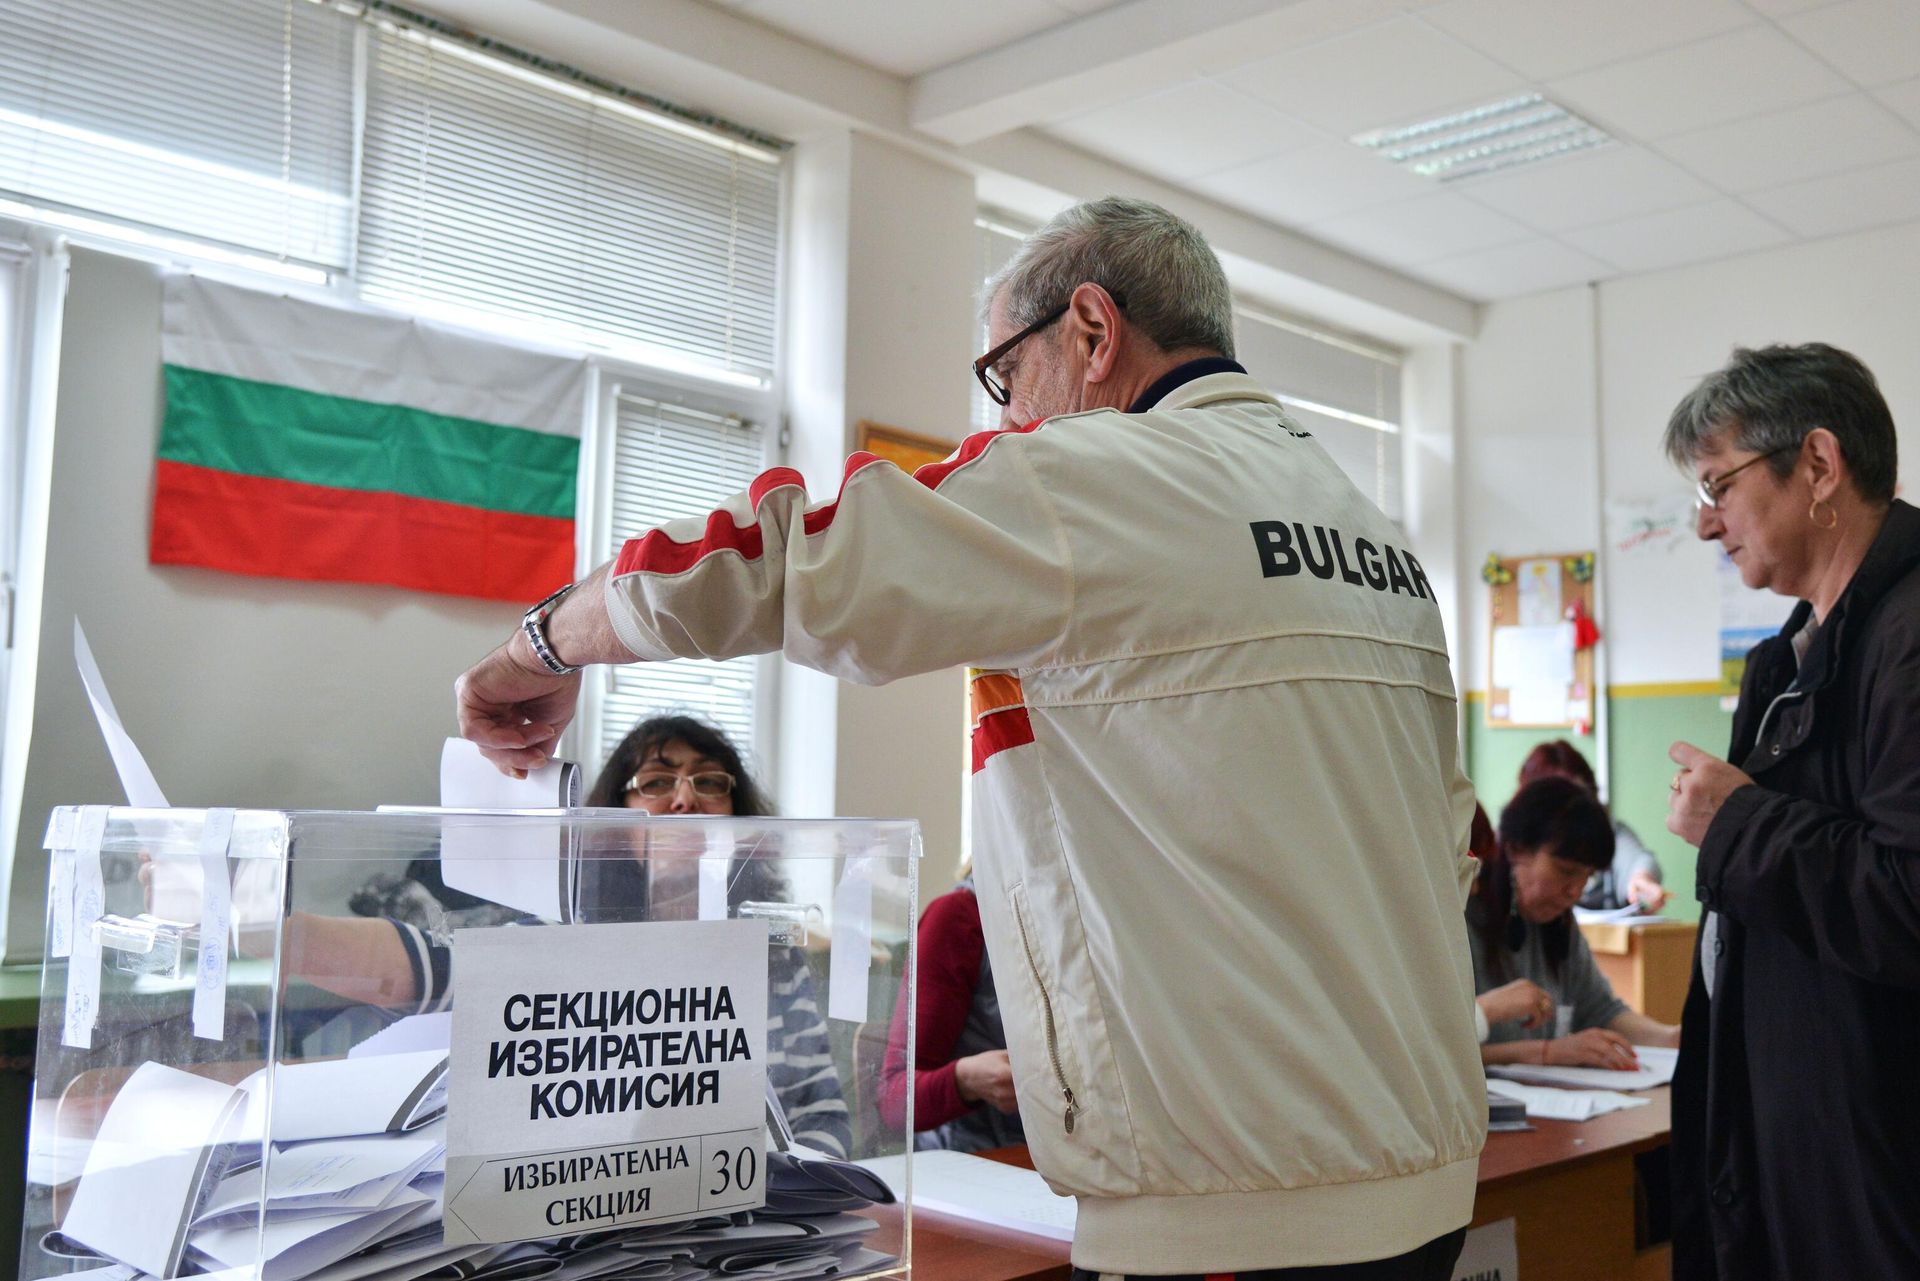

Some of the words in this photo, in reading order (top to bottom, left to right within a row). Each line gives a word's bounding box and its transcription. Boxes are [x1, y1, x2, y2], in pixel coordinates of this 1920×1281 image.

[1249, 521, 1438, 604] BULGAR
[503, 986, 736, 1032] СЕКЦИОННА
[488, 1028, 751, 1078] ИЗБИРАТЕЛНА
[530, 1070, 719, 1120] КОМИСИЯ
[504, 1145, 689, 1192] ИЗБИРАТЕЛНА
[710, 1146, 756, 1195] 30
[545, 1188, 651, 1226] СЕКЦИЯ
